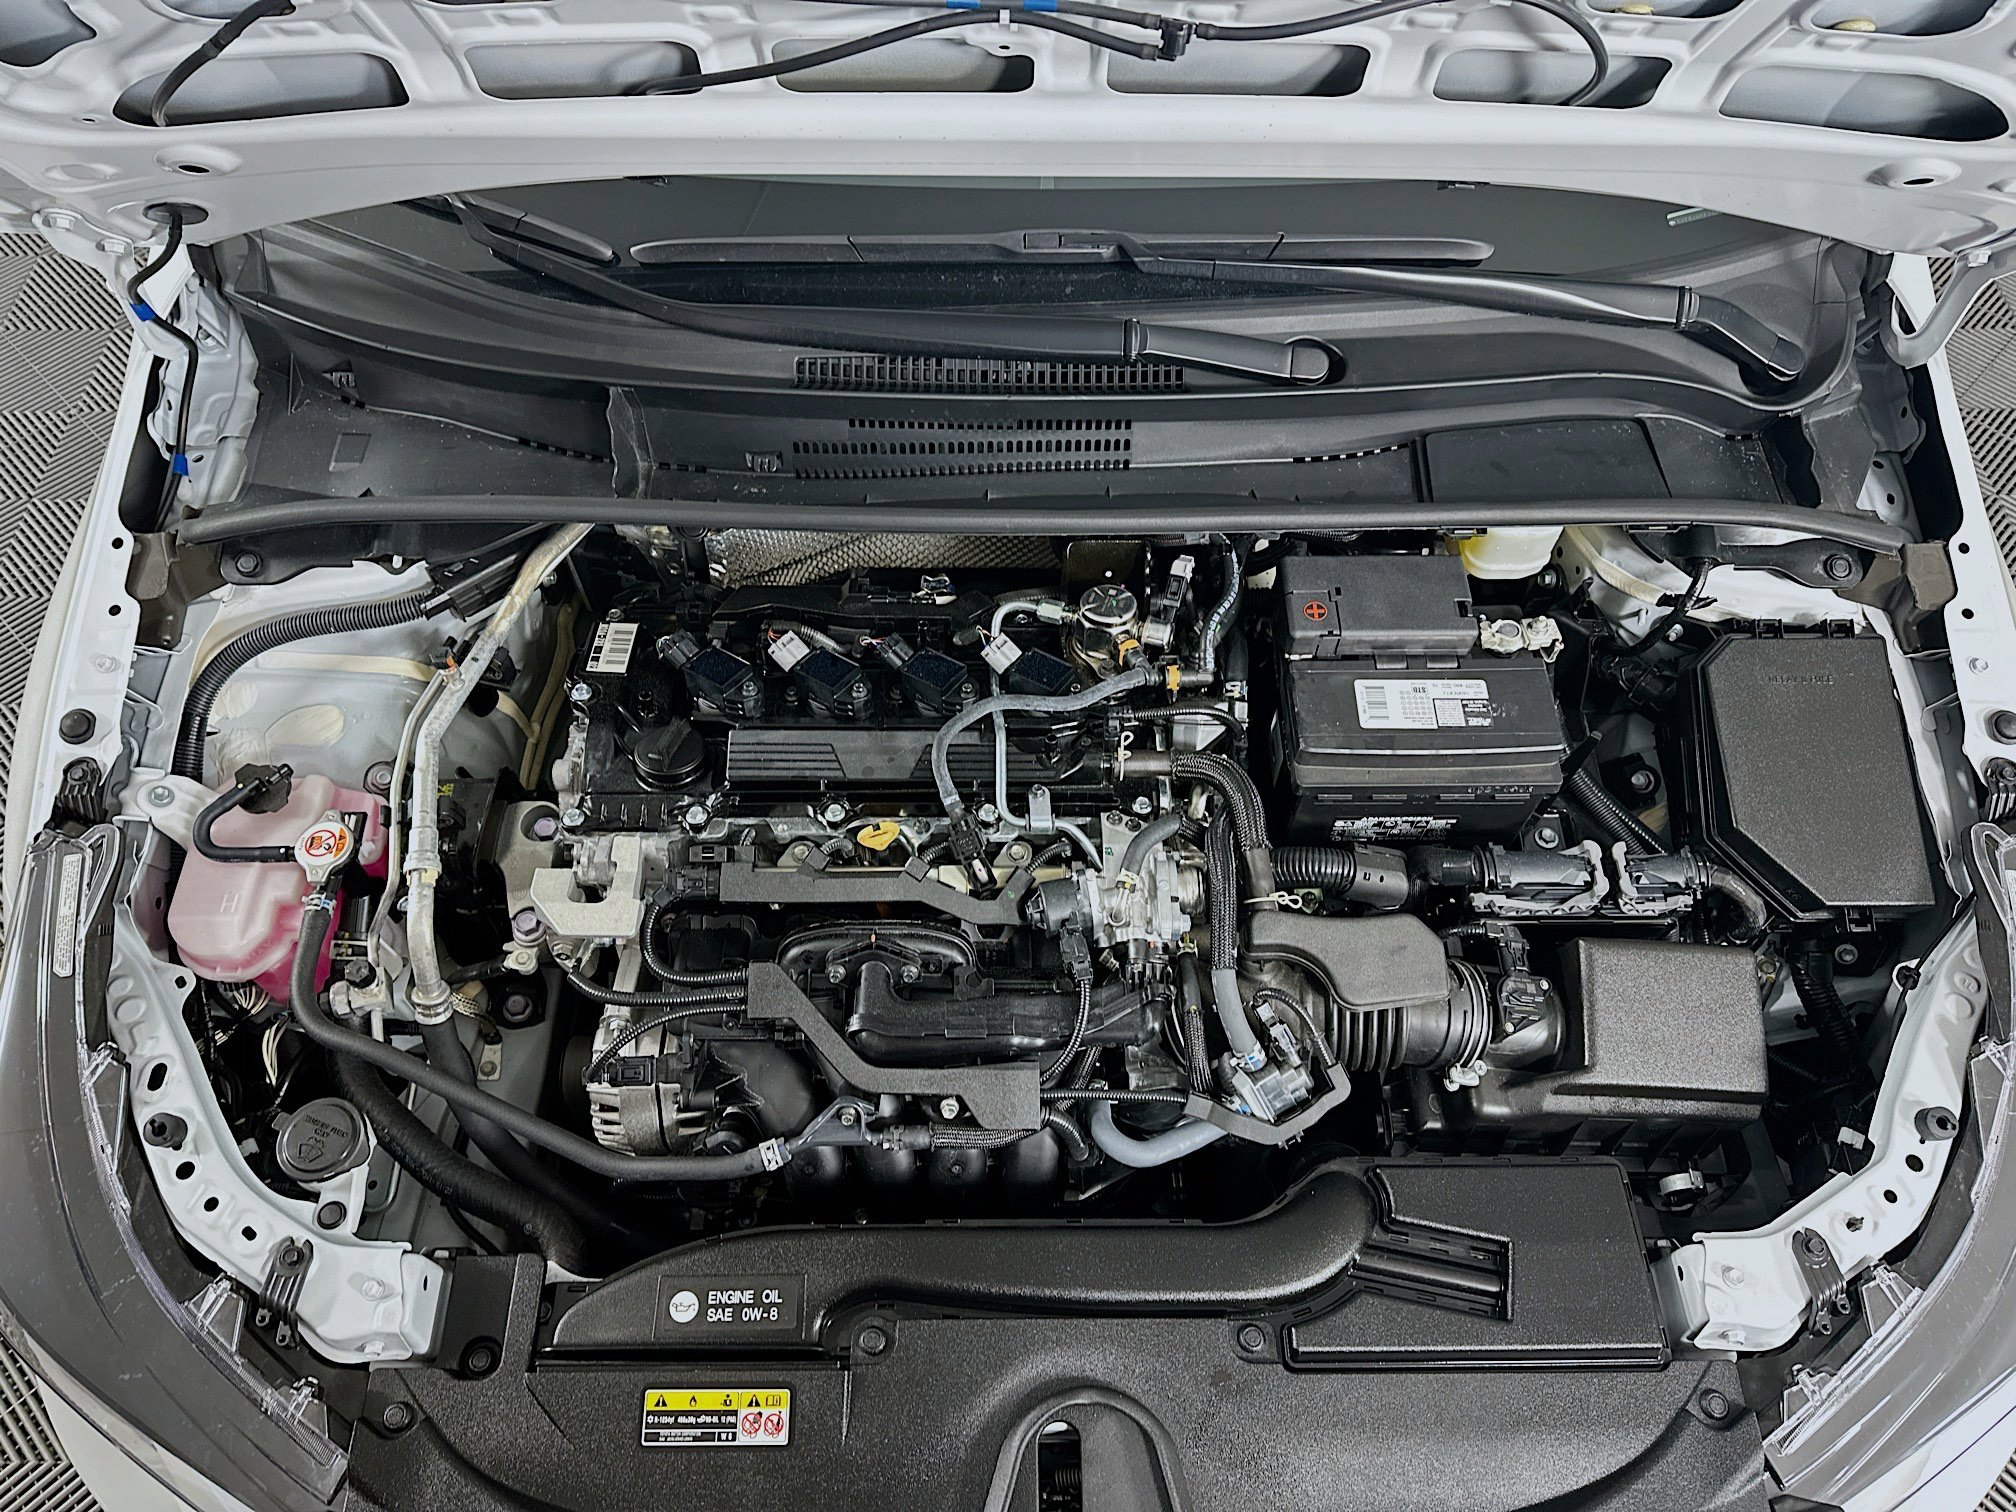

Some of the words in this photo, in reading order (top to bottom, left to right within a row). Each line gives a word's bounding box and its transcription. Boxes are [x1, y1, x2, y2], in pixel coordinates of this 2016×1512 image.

[707, 1290, 754, 1305] ENGINE
[761, 1289, 783, 1304] OIL
[706, 1308, 733, 1322] SAE
[741, 1307, 778, 1321] 0W-8
